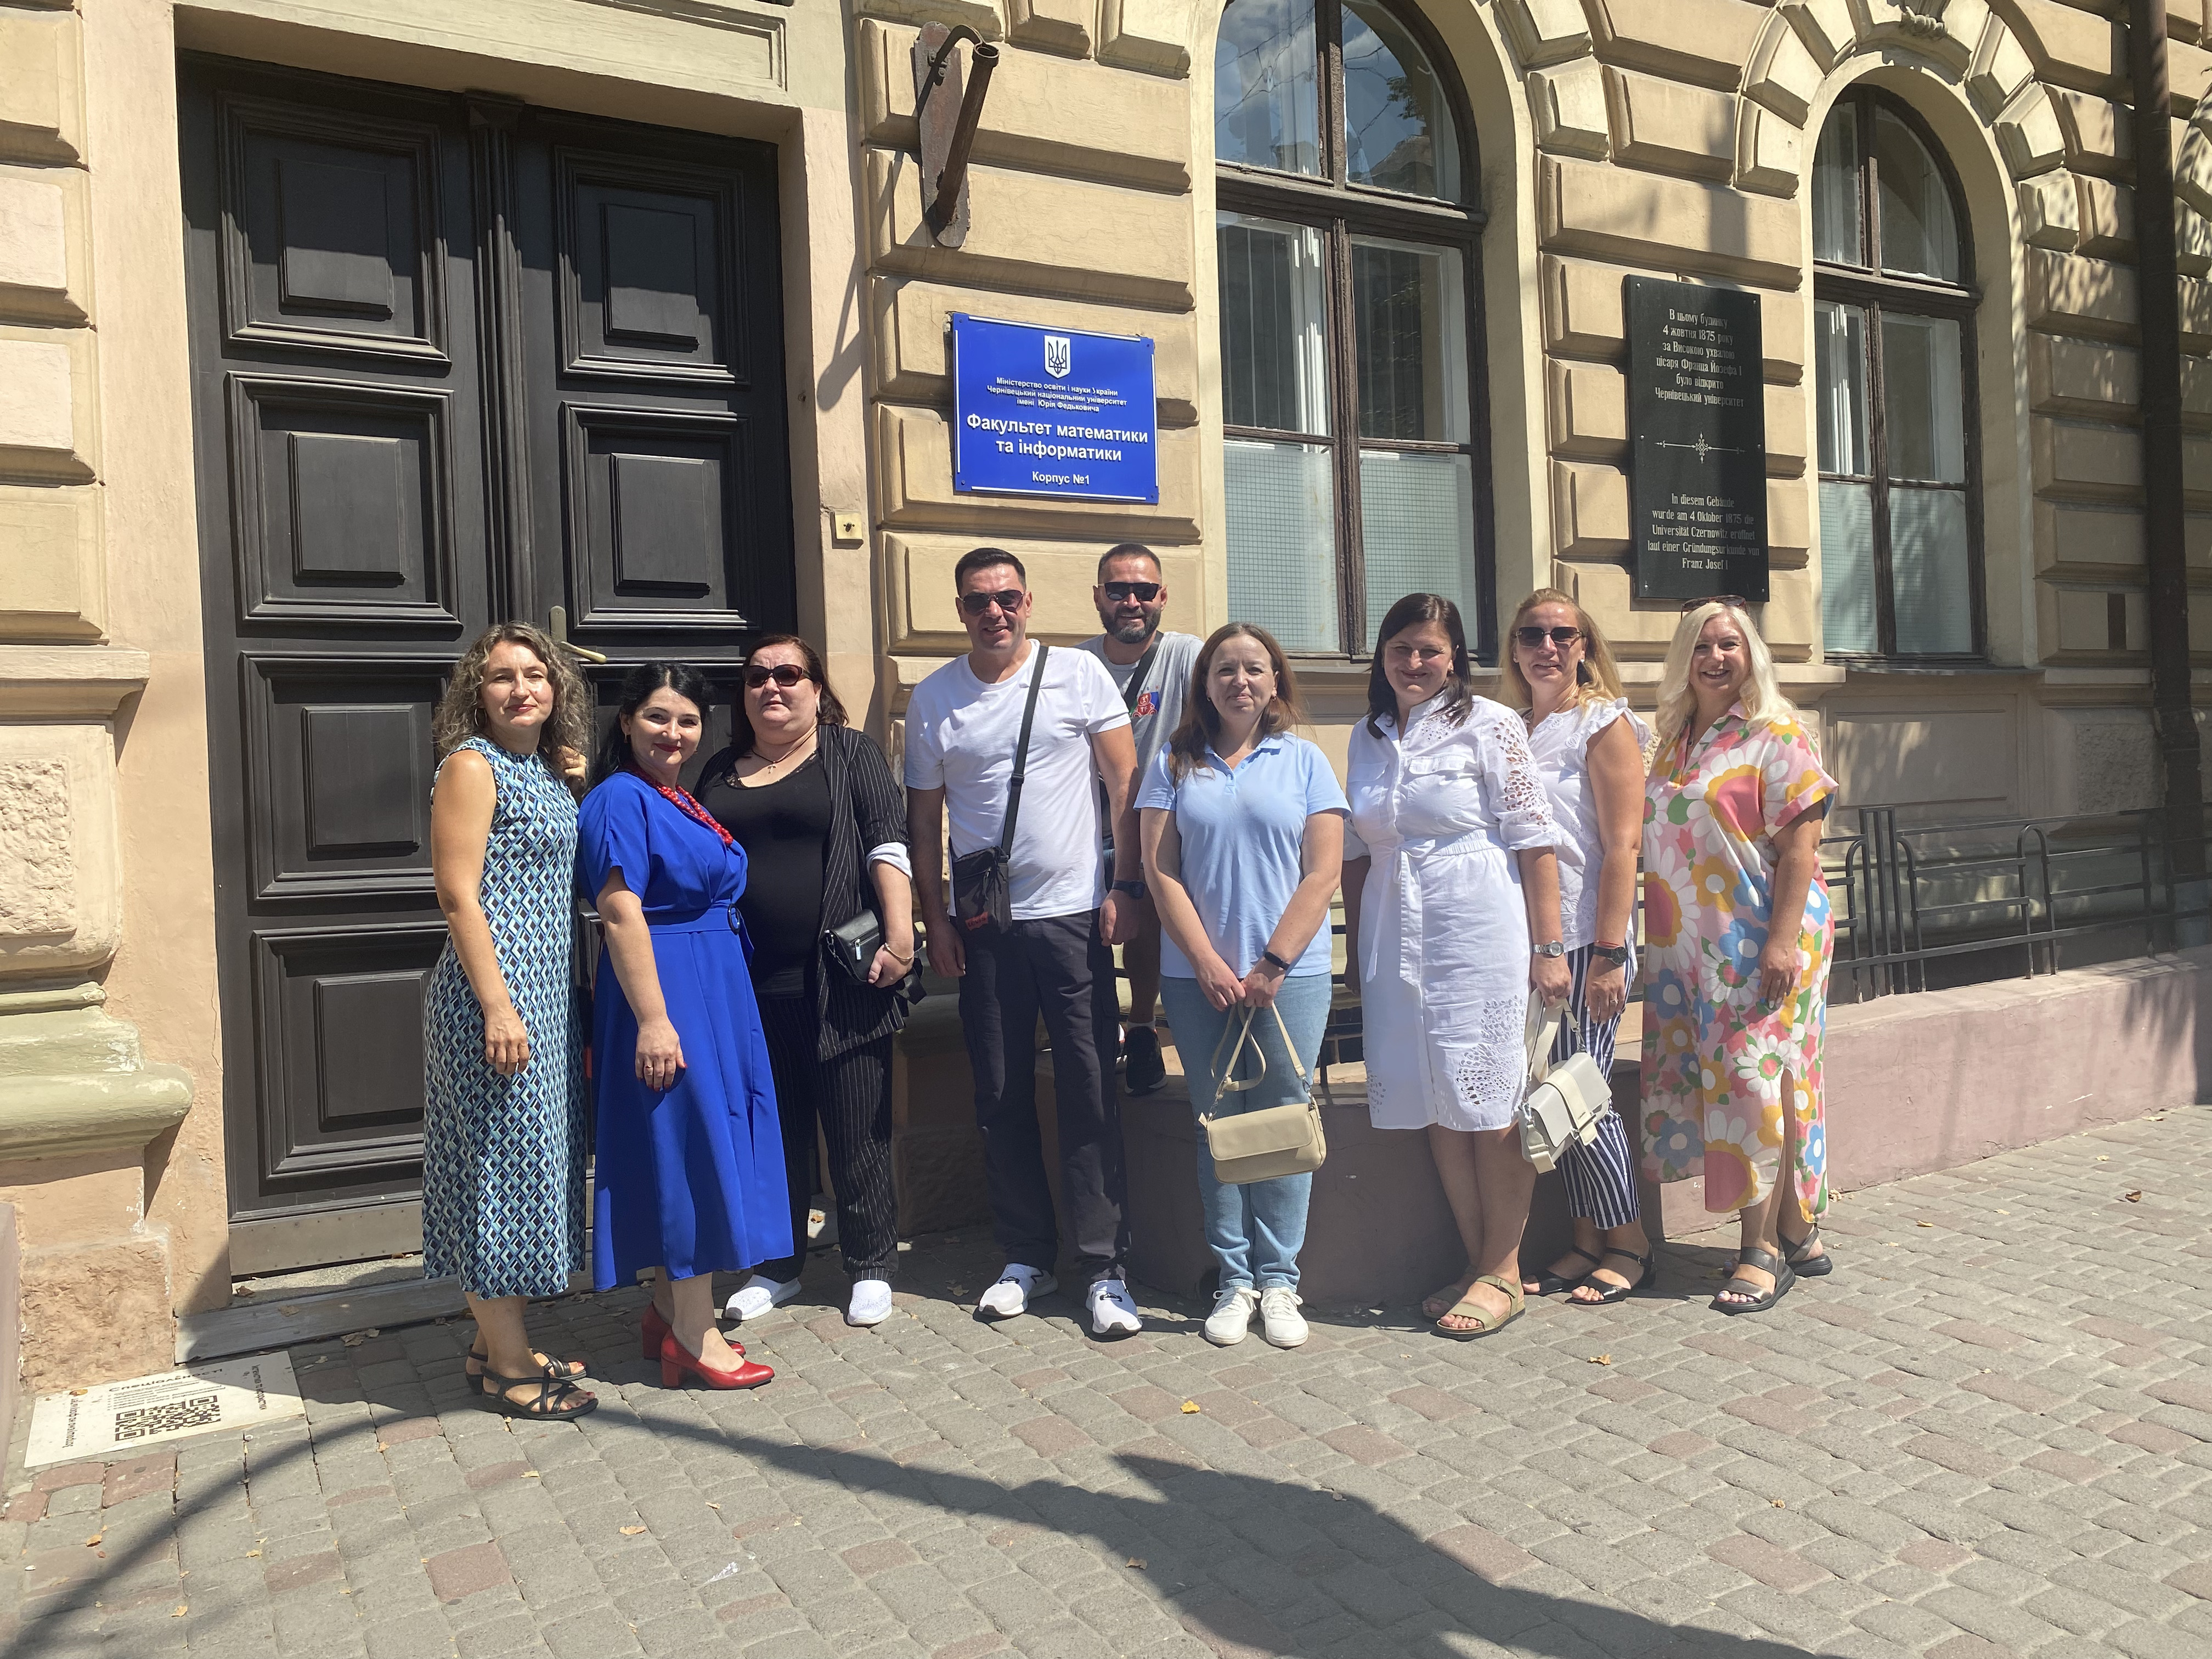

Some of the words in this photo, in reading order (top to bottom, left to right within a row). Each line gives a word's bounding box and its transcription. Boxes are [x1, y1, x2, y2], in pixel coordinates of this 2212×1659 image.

[1669, 308, 1675, 320] В
[1677, 312, 1699, 325] цьому
[1701, 313, 1728, 329] будинку
[1662, 324, 1669, 335] 4
[1671, 327, 1697, 338] жовтня
[1699, 329, 1716, 341] 1875
[1718, 334, 1734, 346] року
[1662, 342, 1671, 351] за
[1673, 341, 1703, 356] Високою
[1706, 348, 1735, 359] ухвалою
[1656, 356, 1679, 370] цісаря
[1681, 358, 1709, 373] Франца
[1711, 360, 1737, 376] Йозефа
[996, 376, 1042, 388] Міністерство
[1071, 386, 1091, 394] науки
[1676, 373, 1692, 387] було
[1695, 376, 1724, 390] відкрито
[1017, 397, 1034, 405] імені
[1037, 399, 1056, 408] Юрія
[1057, 402, 1099, 412] Федьковича
[1086, 396, 1127, 406] університет
[1655, 387, 1702, 403] Чернівецький
[1704, 394, 1744, 407] університет
[967, 413, 1052, 435] Факультет
[1057, 425, 1148, 443] математики
[996, 439, 1014, 453] та
[1019, 438, 1122, 461] інформатики
[1032, 471, 1070, 484] Корпус
[1073, 474, 1090, 485] №1
[1672, 493, 1678, 504] In
[1680, 494, 1705, 506] diesem
[1707, 495, 1735, 508] Gebäude
[1652, 509, 1674, 520] wurde
[1677, 511, 1688, 521] am
[1725, 513, 1742, 524] 1875
[1745, 514, 1754, 524] die
[1652, 524, 1689, 537] Universität
[1691, 527, 1728, 539] Czernowitz
[1647, 540, 1660, 551] laut
[1662, 542, 1680, 552] einer
[1683, 541, 1746, 556] Gründungsurkunde
[1748, 548, 1760, 556] von
[1682, 557, 1703, 569] Franz
[1705, 559, 1724, 570] Josef
